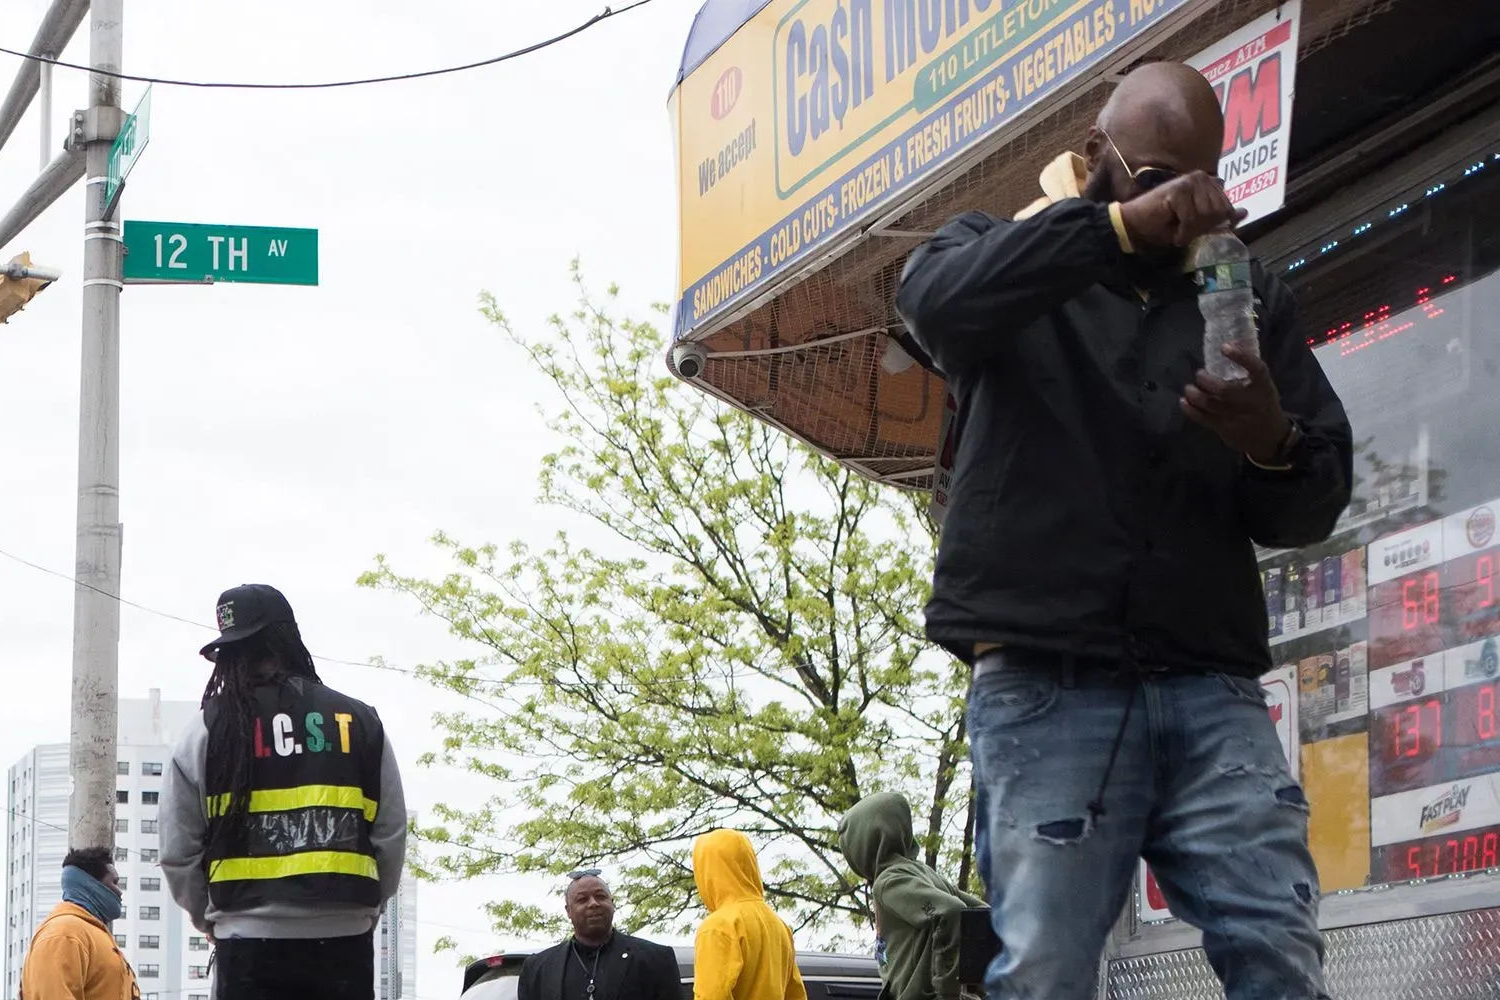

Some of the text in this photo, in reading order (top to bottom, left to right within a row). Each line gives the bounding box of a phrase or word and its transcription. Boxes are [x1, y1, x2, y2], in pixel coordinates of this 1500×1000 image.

[929, 0, 1060, 92] 110 LITLETO
[1235, 33, 1266, 66] ATM
[693, 246, 762, 321] SANDWICHES
[770, 218, 800, 267] COLD
[841, 154, 891, 219] FROZEN
[894, 146, 904, 183] &
[906, 111, 951, 175] FRESH
[1012, 0, 1116, 101] VEGETABLES
[698, 117, 757, 197] We accept
[1224, 137, 1279, 182] INSIDE
[154, 233, 288, 272] 12 TH AV
